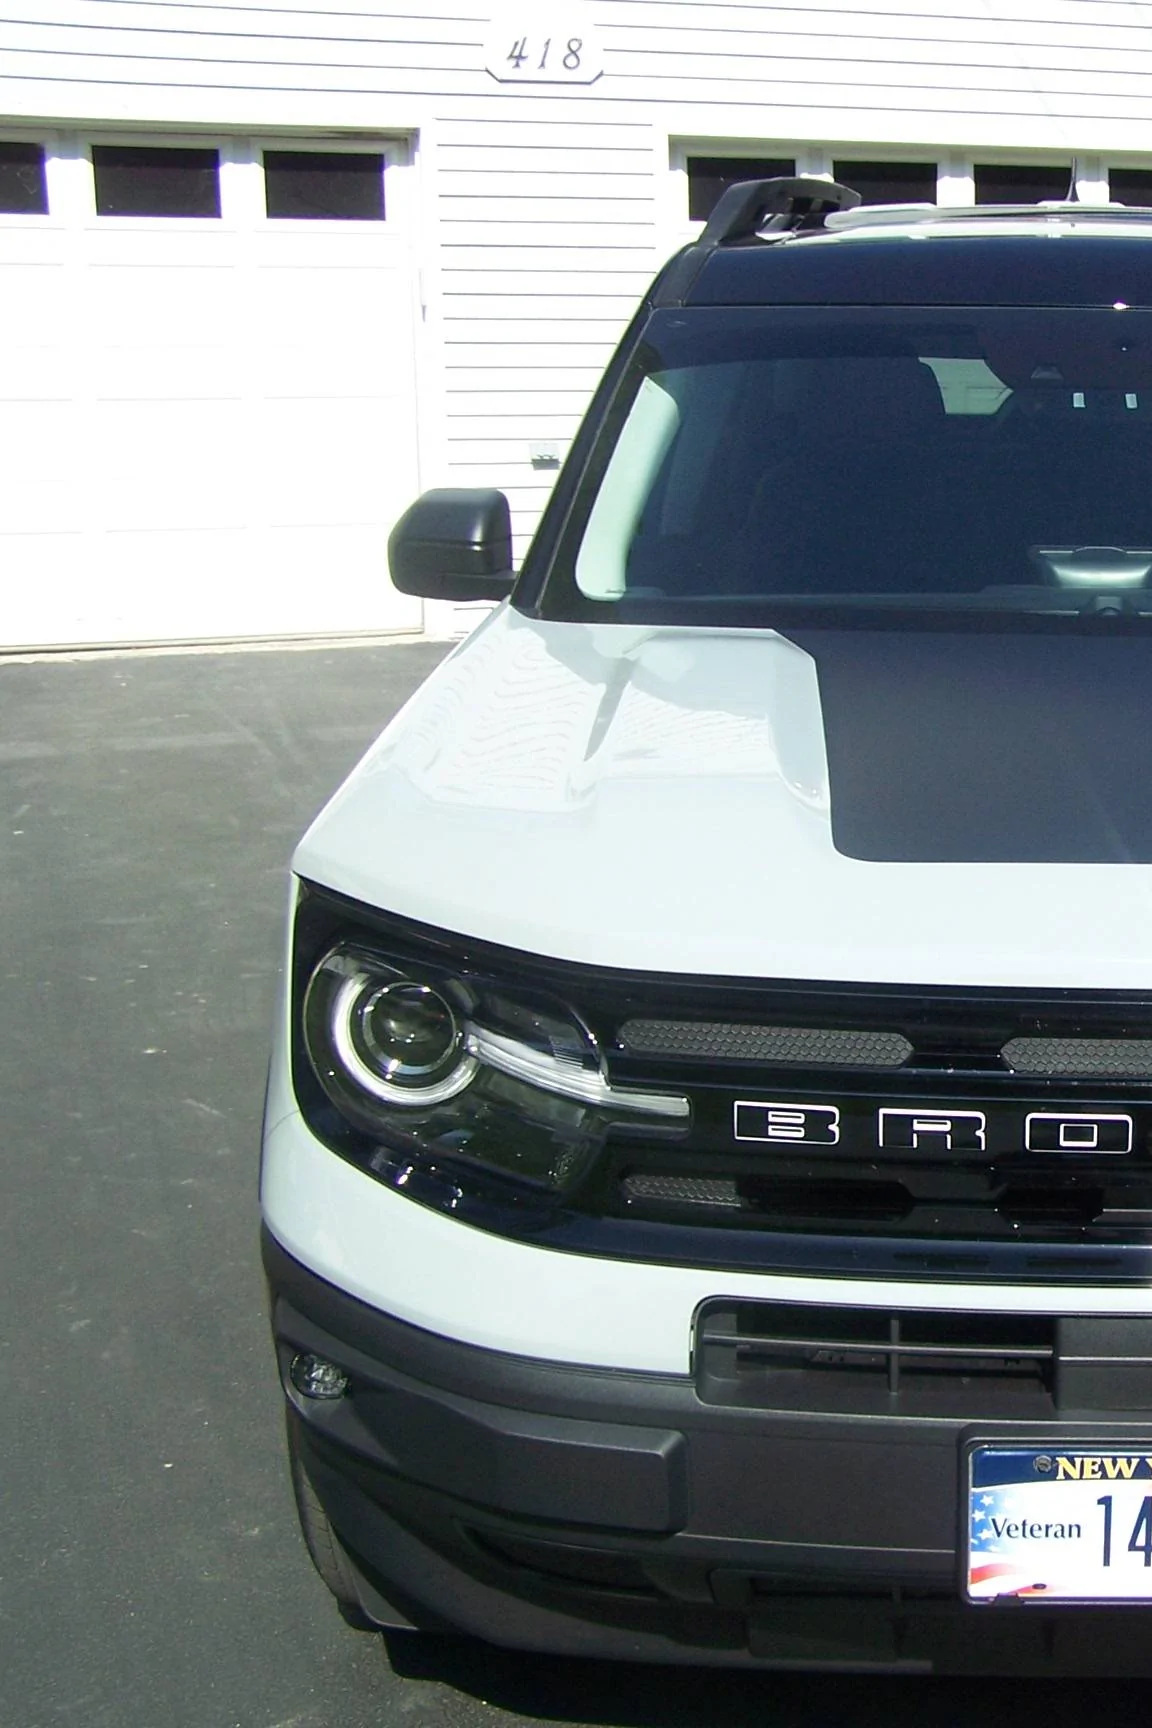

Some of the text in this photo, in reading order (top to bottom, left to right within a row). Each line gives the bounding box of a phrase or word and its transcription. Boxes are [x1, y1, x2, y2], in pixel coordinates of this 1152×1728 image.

[506, 36, 583, 70] 418
[1055, 1456, 1141, 1480] NEW
[990, 1516, 1082, 1539] Veteran
